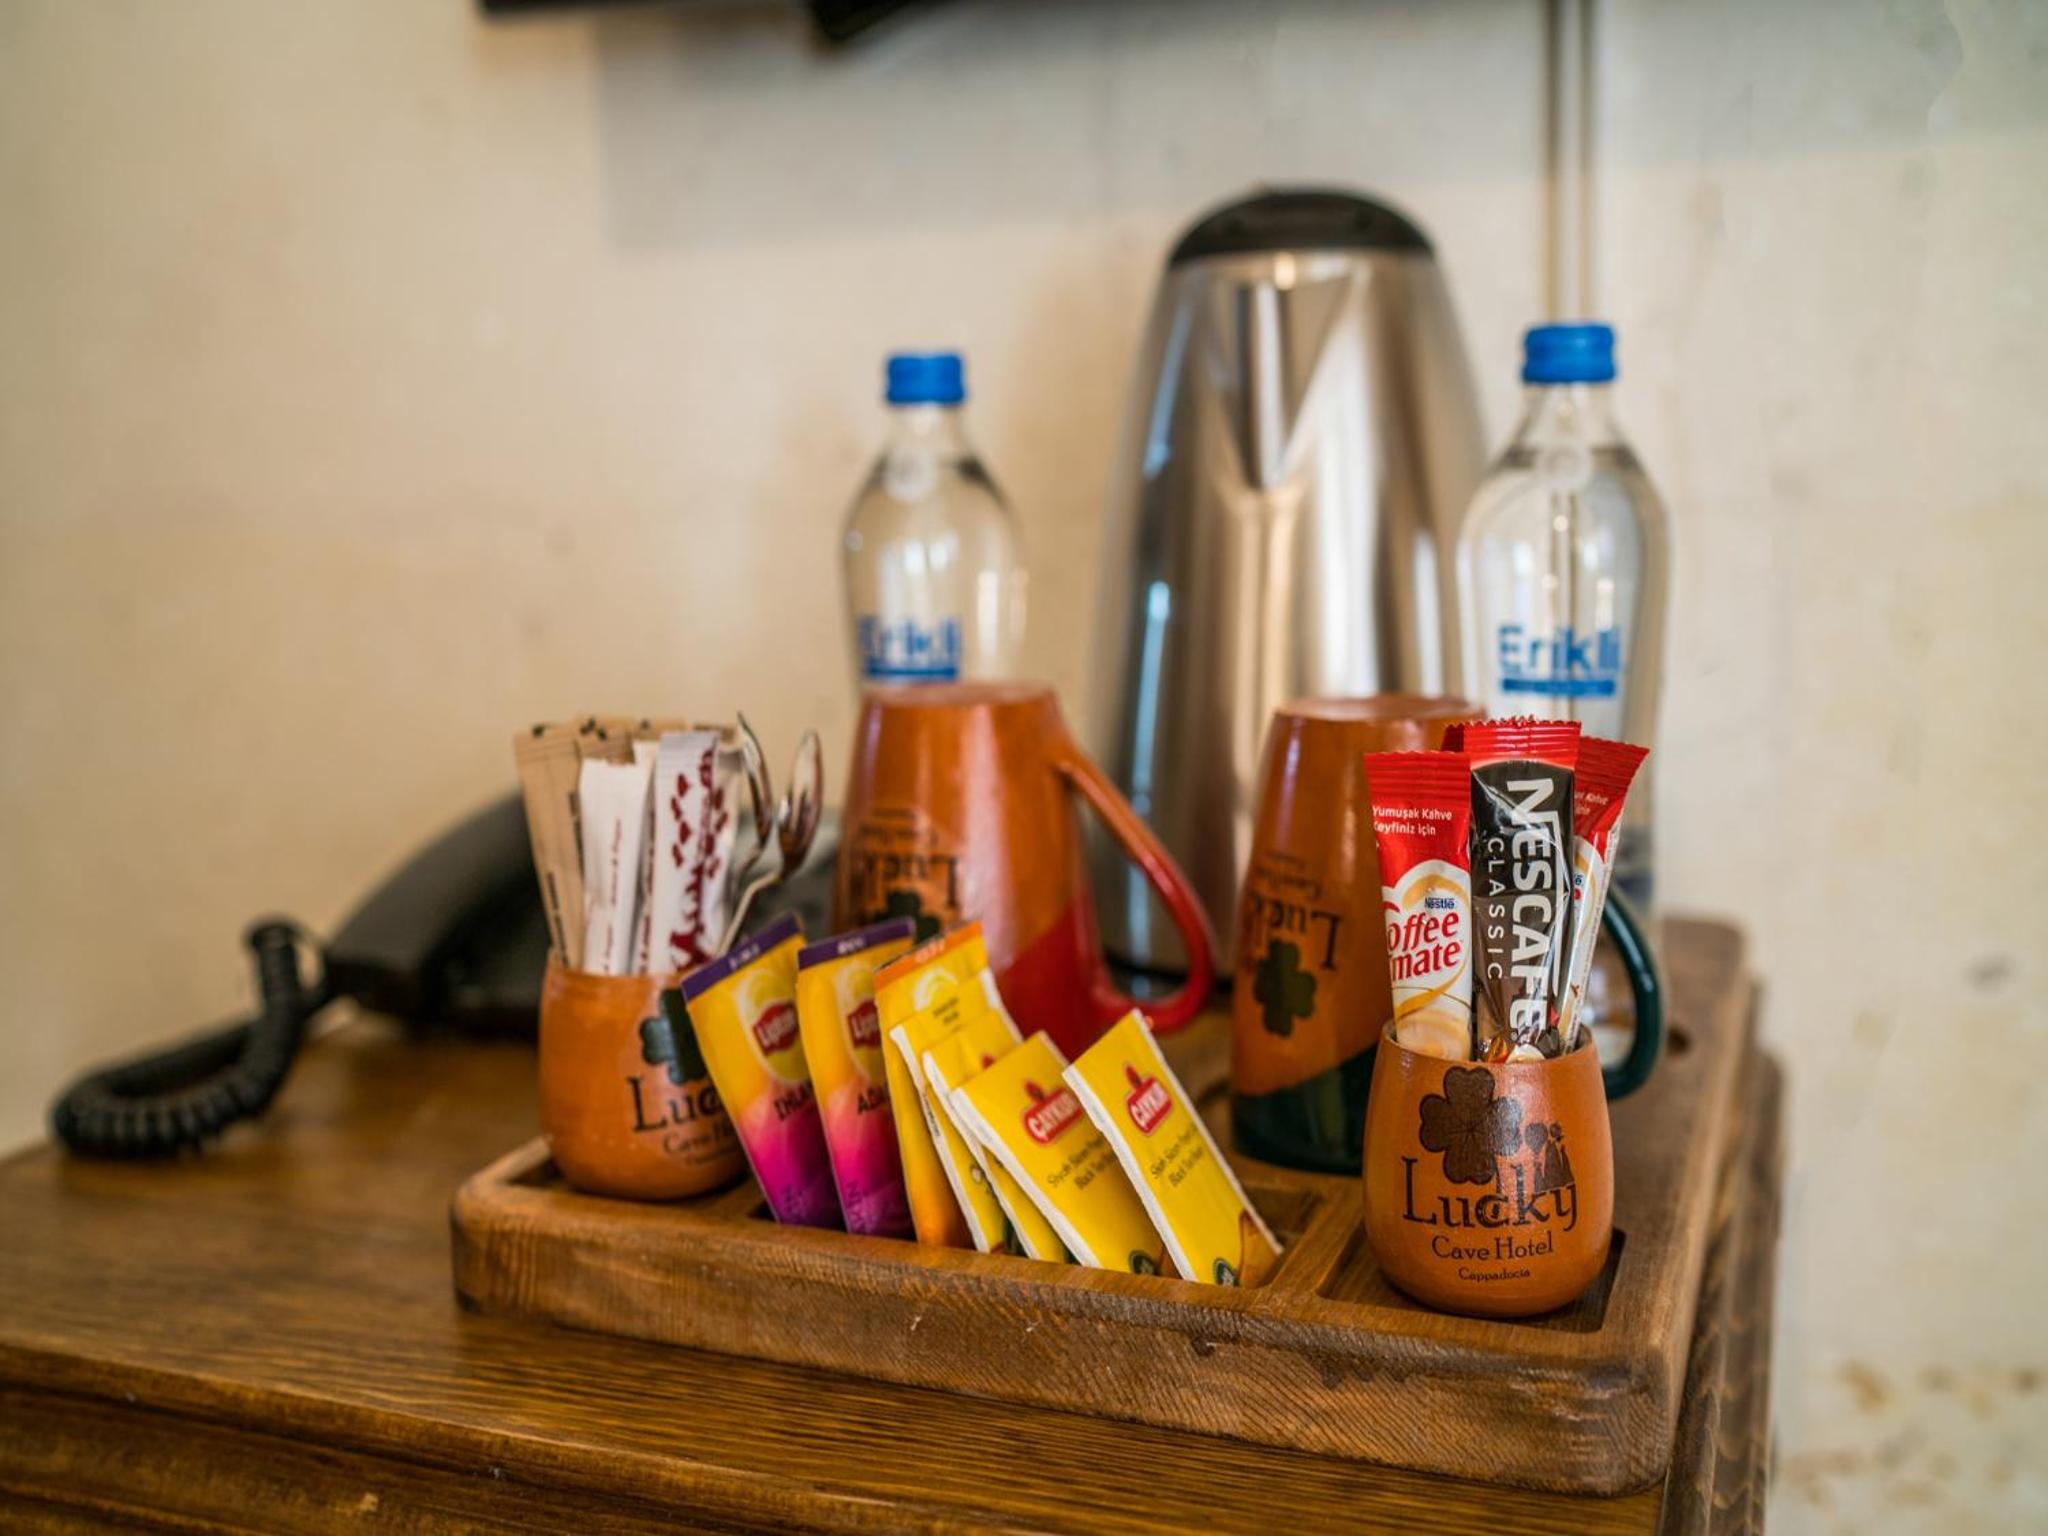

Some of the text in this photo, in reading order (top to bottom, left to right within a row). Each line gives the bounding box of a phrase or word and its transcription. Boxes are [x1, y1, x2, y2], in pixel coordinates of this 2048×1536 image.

[1371, 805, 1453, 821] Yumuşak Kahve
[1487, 836, 1505, 980] CLASSIC
[1401, 1155, 1578, 1233] Lucky
[1431, 1230, 1554, 1261] Cave Hotel
[1457, 1266, 1531, 1283] Cappadocia
